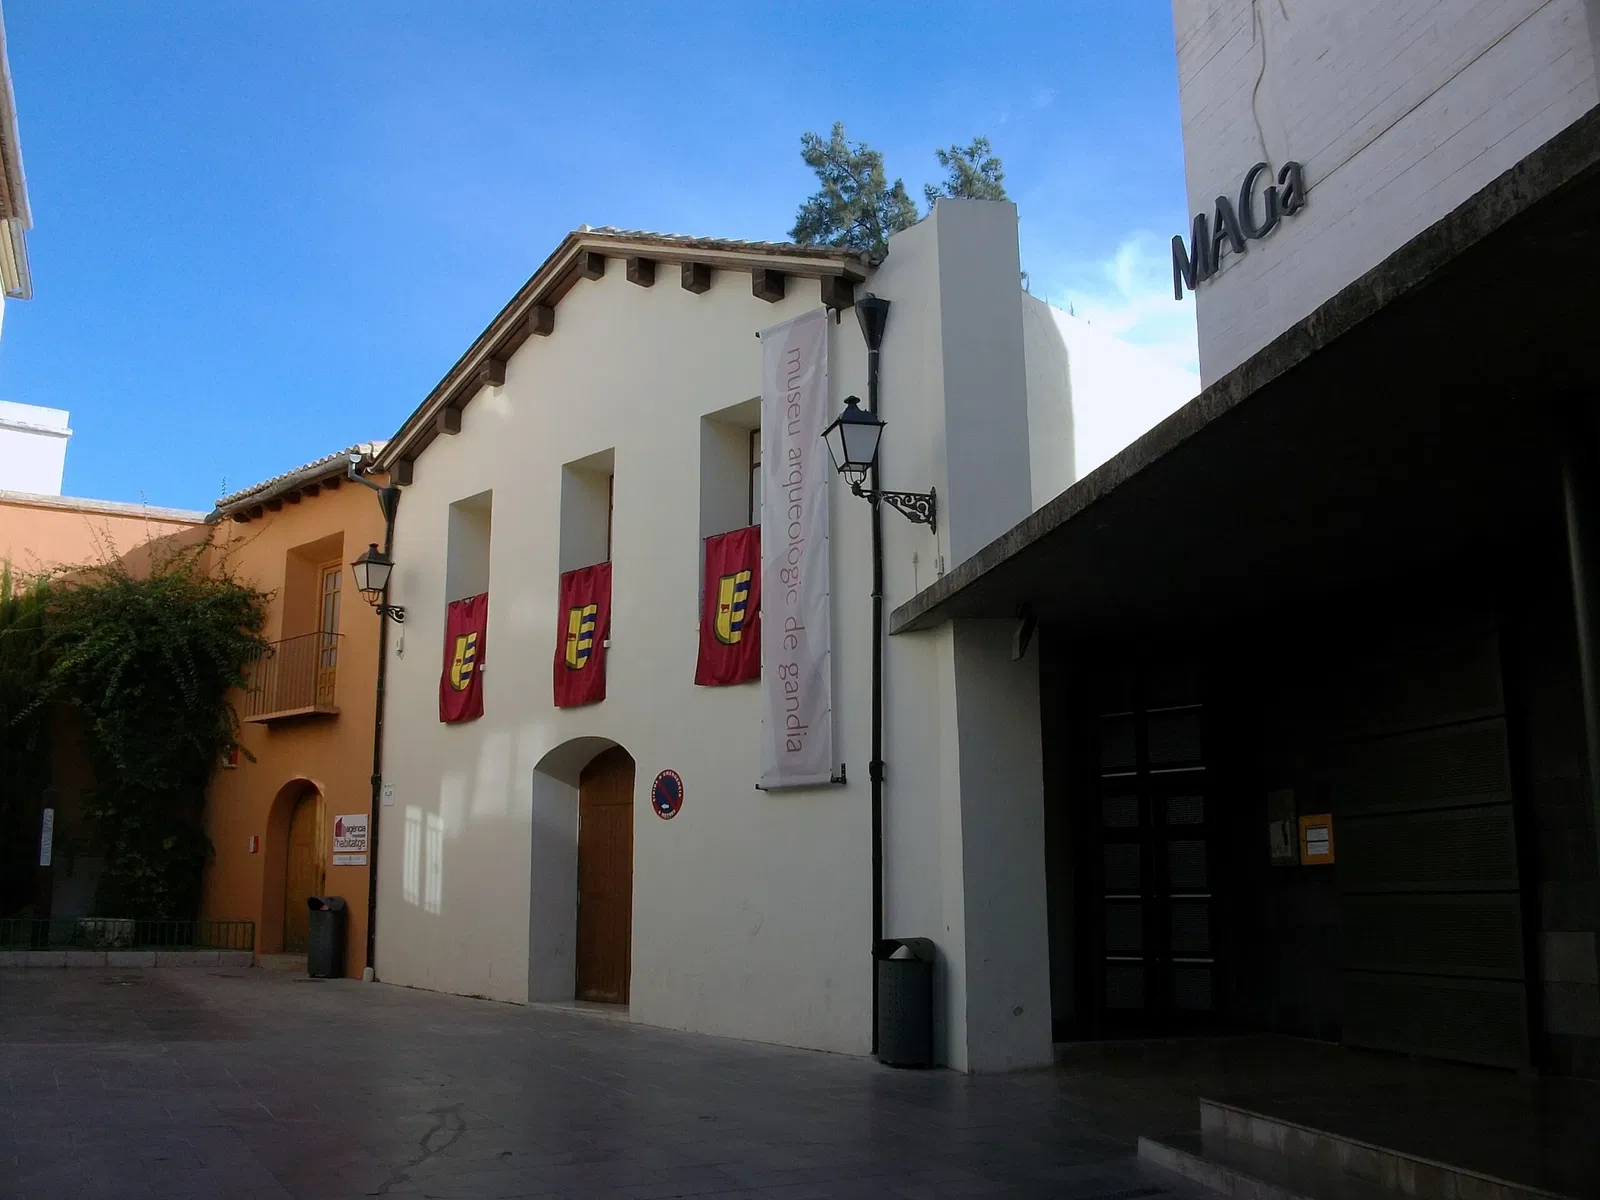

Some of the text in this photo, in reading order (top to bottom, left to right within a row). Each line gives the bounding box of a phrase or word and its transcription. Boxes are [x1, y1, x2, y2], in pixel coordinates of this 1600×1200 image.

[1172, 161, 1305, 300] MAGa
[778, 347, 809, 753] museu arqueològic de gandia
